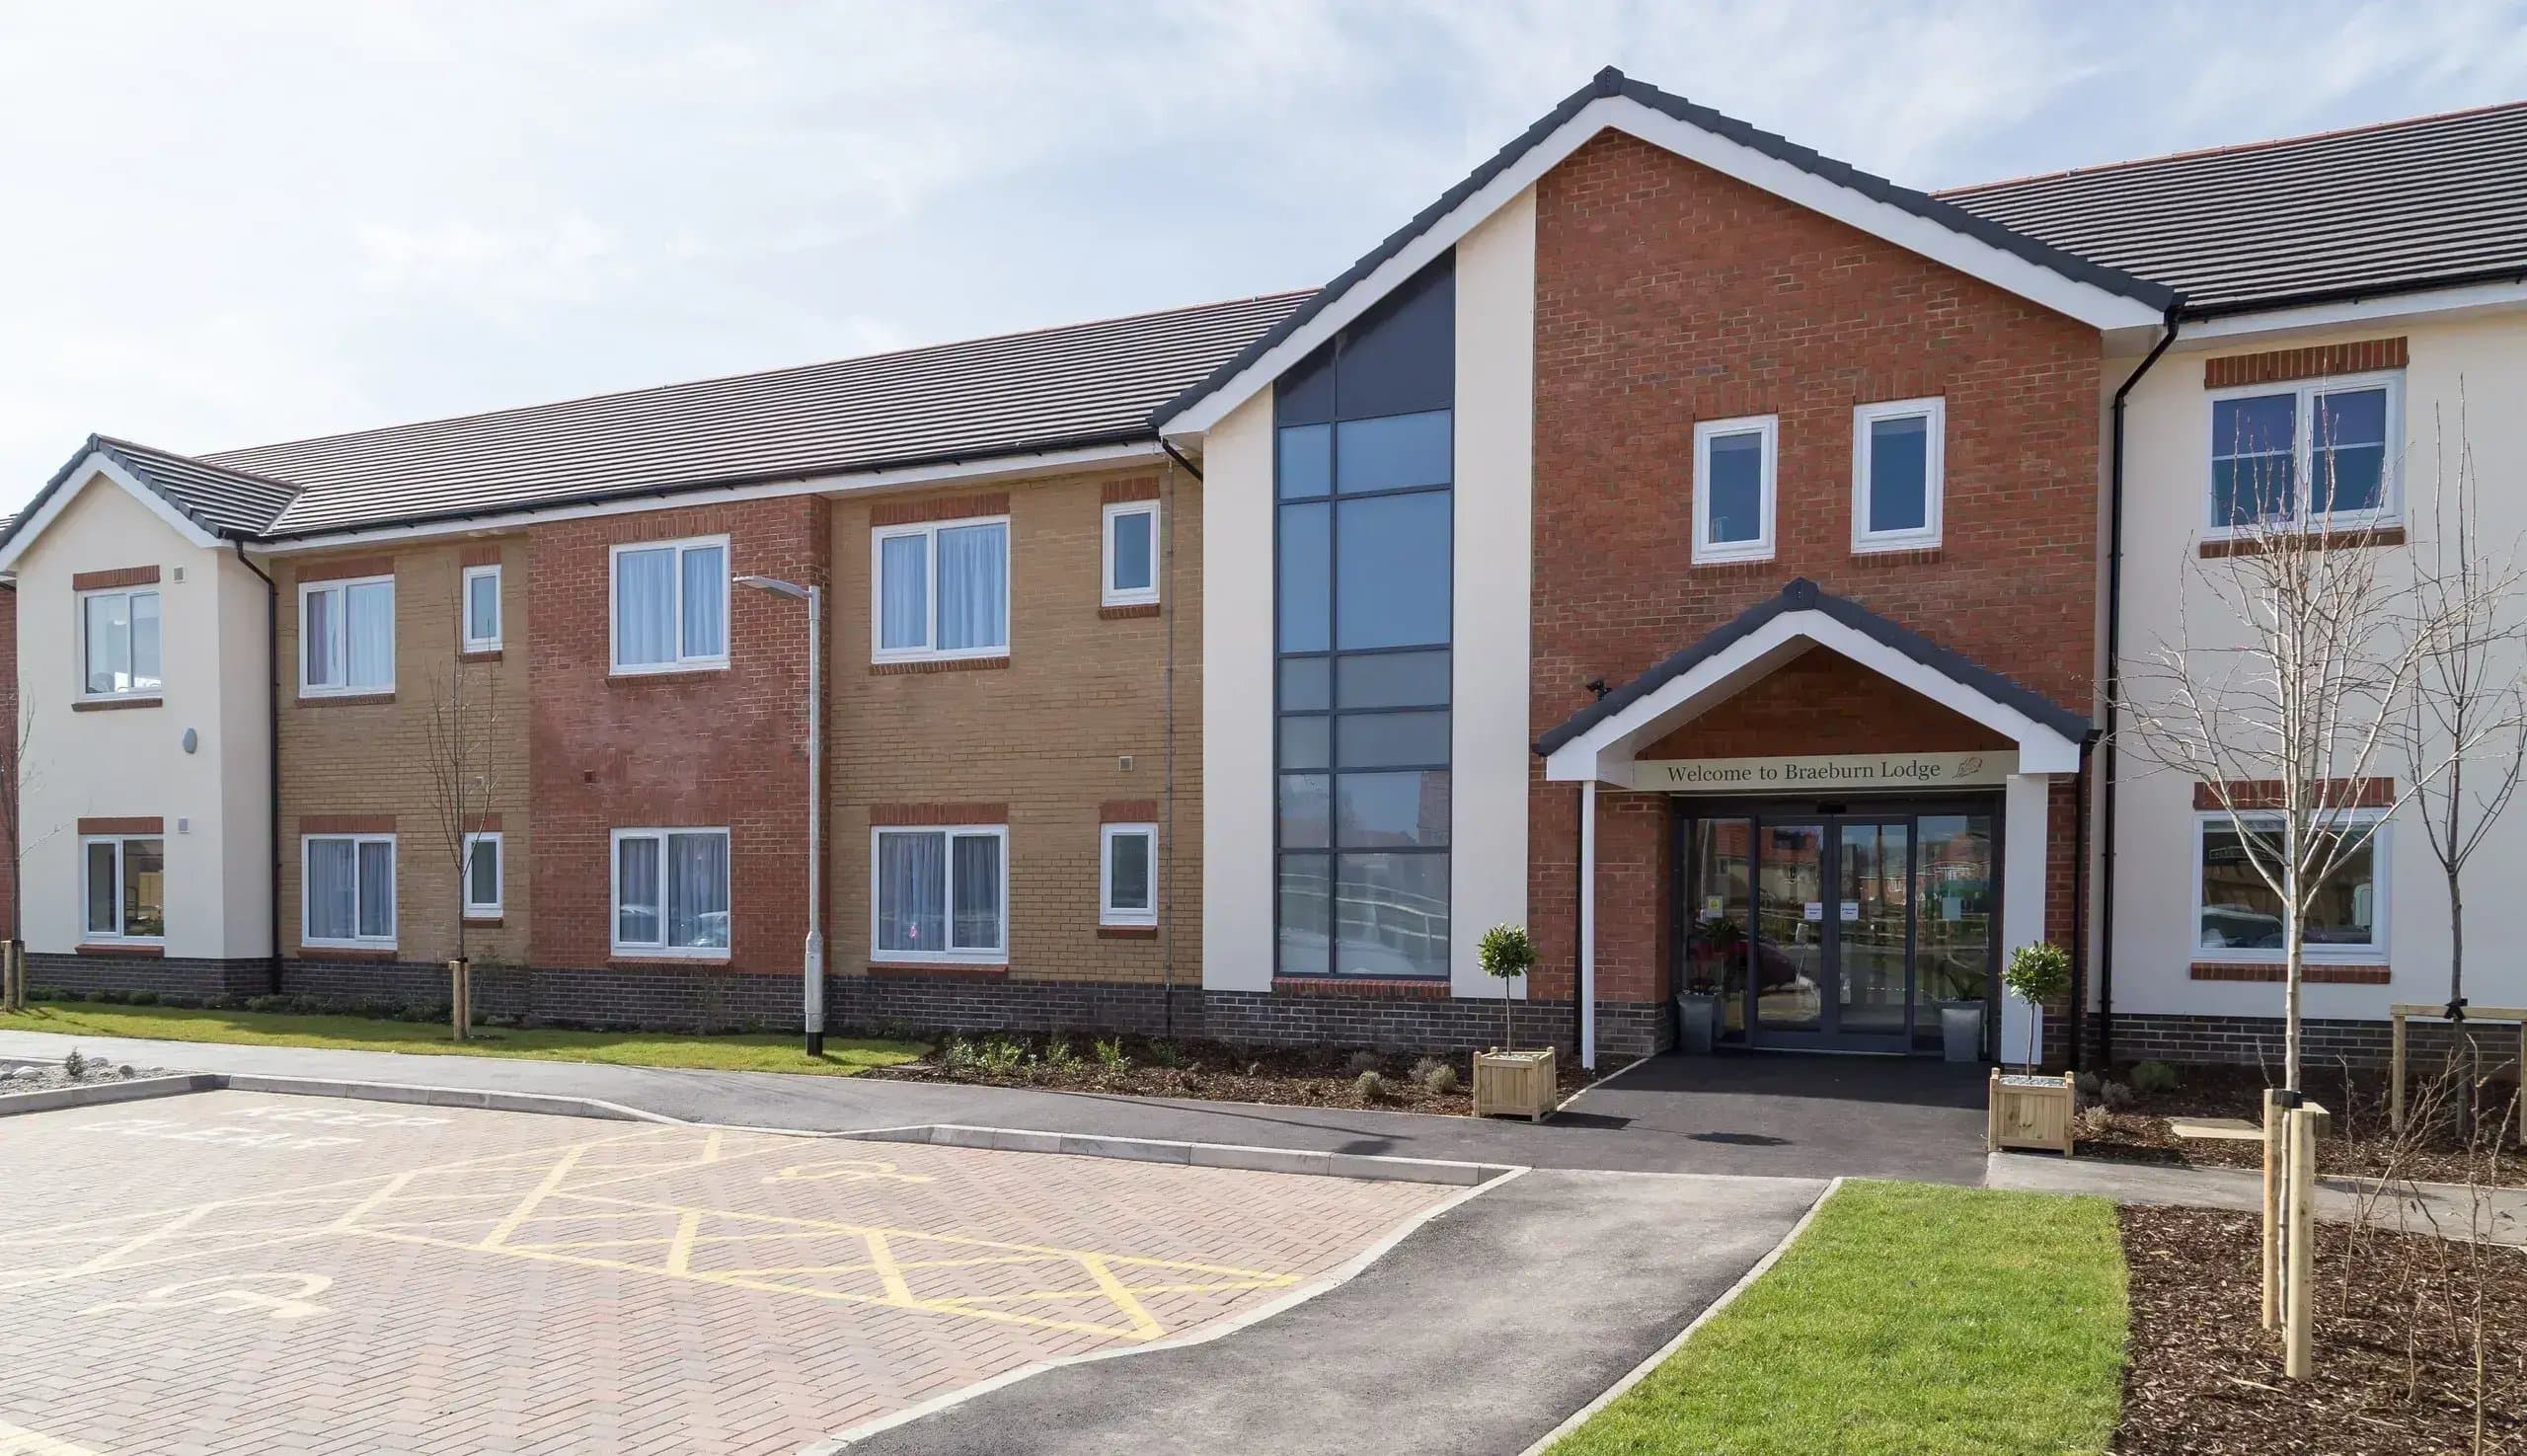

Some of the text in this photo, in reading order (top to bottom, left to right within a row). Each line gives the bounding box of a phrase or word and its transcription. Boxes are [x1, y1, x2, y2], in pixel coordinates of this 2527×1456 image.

[1666, 759, 1941, 782] Welcome to Braeburn Lodge
[220, 1105, 455, 1127] KEEP
